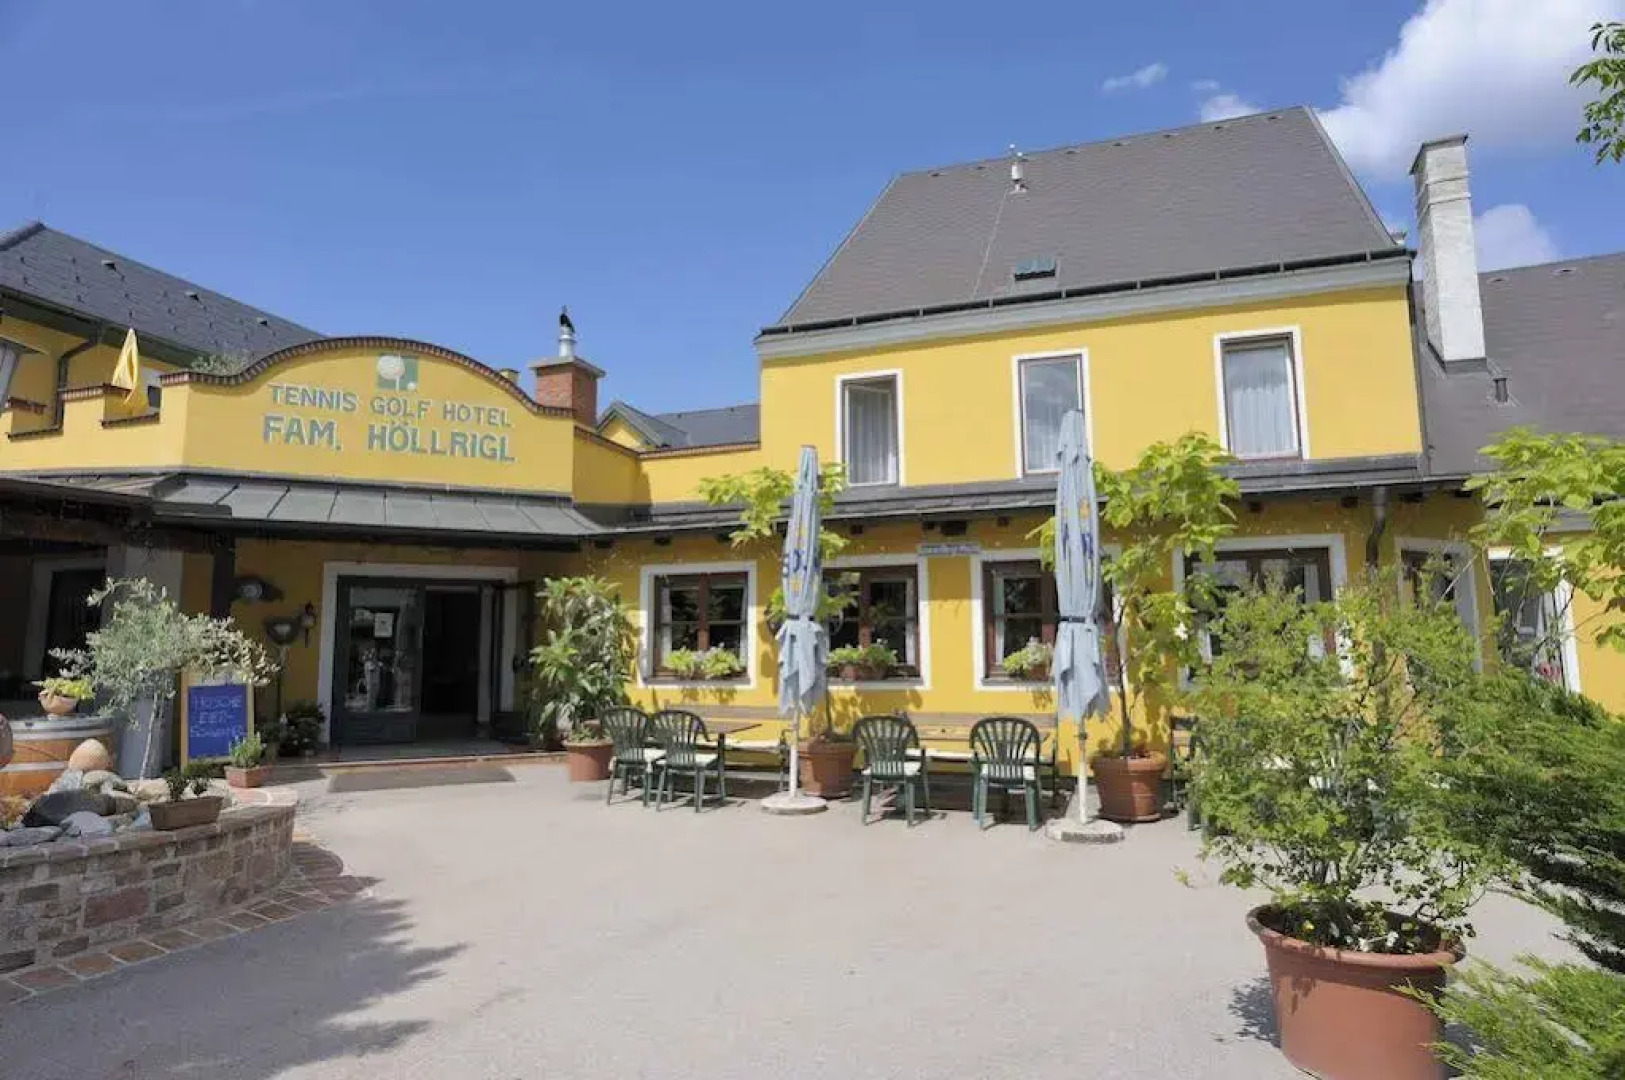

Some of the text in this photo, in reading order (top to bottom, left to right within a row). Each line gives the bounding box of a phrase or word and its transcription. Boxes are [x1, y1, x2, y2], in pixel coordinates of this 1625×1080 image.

[268, 384, 512, 428] TENNIS GOLF HOTEL
[263, 414, 516, 462] FAM. HÖLLRIGL
